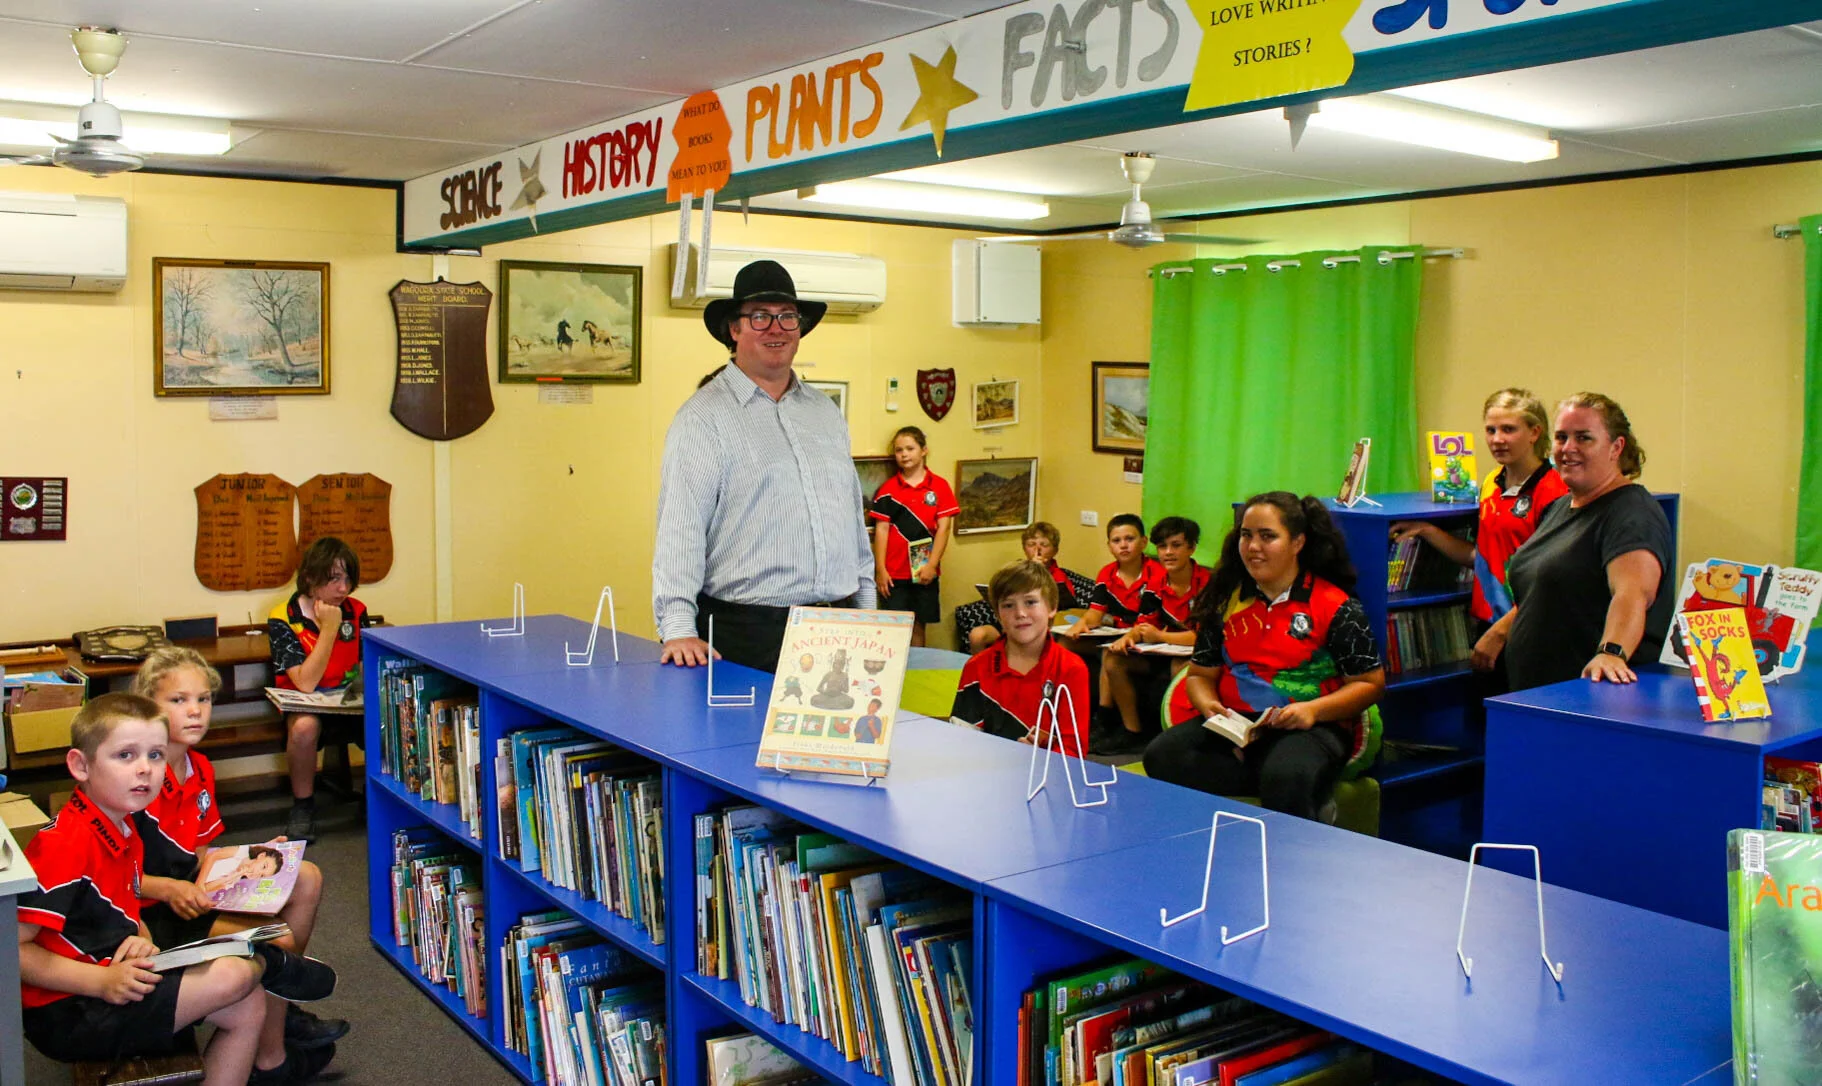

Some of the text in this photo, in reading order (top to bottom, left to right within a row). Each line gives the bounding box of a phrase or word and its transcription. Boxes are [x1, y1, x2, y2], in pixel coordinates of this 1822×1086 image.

[1210, 3, 1254, 26] LOVE
[1001, 0, 1180, 110] FACTS
[1233, 40, 1301, 66] STORIES
[683, 100, 721, 119] WHAT DO
[745, 52, 884, 163] PLANTS
[688, 132, 713, 148] BOOKS
[563, 116, 663, 199] HISTORY
[671, 166, 694, 181] MEAN
[695, 164, 707, 176] TO
[440, 161, 503, 231] SCIENCE
[435, 286, 455, 295] STATE
[1432, 434, 1473, 456] LOL
[219, 478, 266, 490] JUNIOR
[321, 477, 365, 489] SENIOR
[1779, 581, 1815, 597] Teddy
[1687, 612, 1732, 630] FOX IN
[1699, 625, 1746, 641] SOCKS
[792, 636, 896, 659] ANCIENT JAPAN
[90, 817, 121, 852] PINDI
